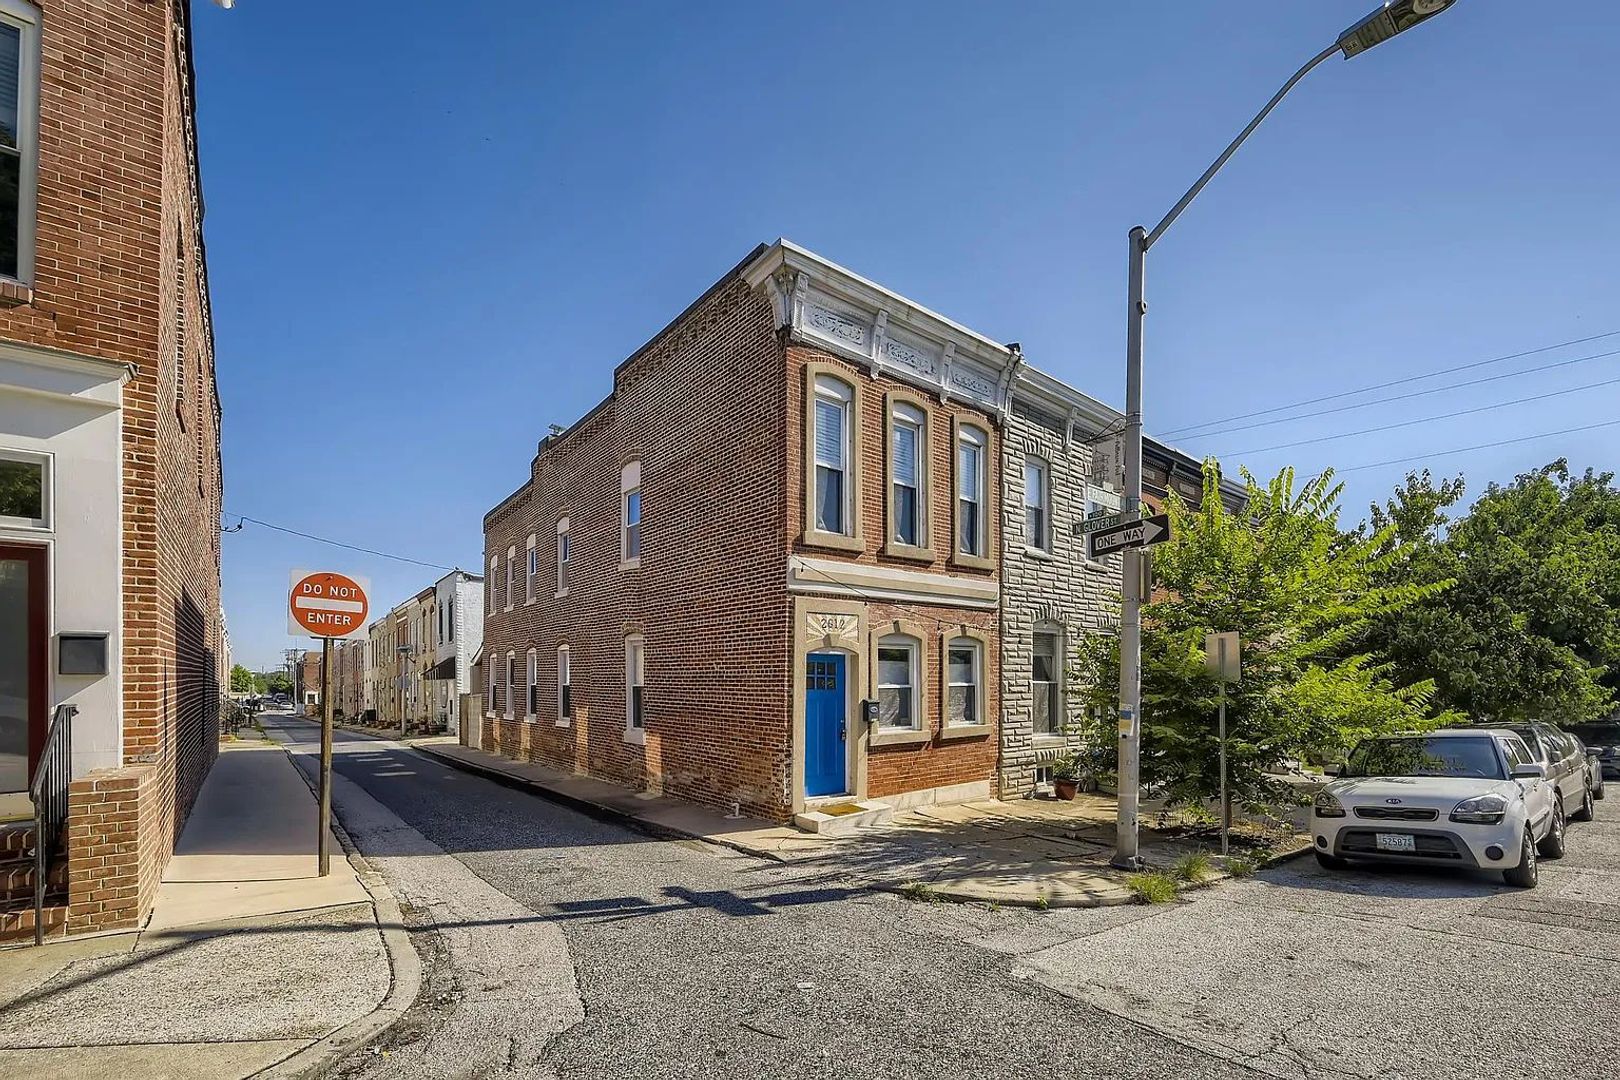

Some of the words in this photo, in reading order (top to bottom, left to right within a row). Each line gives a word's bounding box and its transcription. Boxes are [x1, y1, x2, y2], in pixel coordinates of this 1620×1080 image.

[1083, 517, 1110, 532] GLOVER
[1097, 533, 1117, 548] ONE
[1123, 526, 1146, 542] WAY
[303, 583, 322, 595] DO
[329, 585, 358, 598] NOT
[307, 612, 351, 625] ENTER
